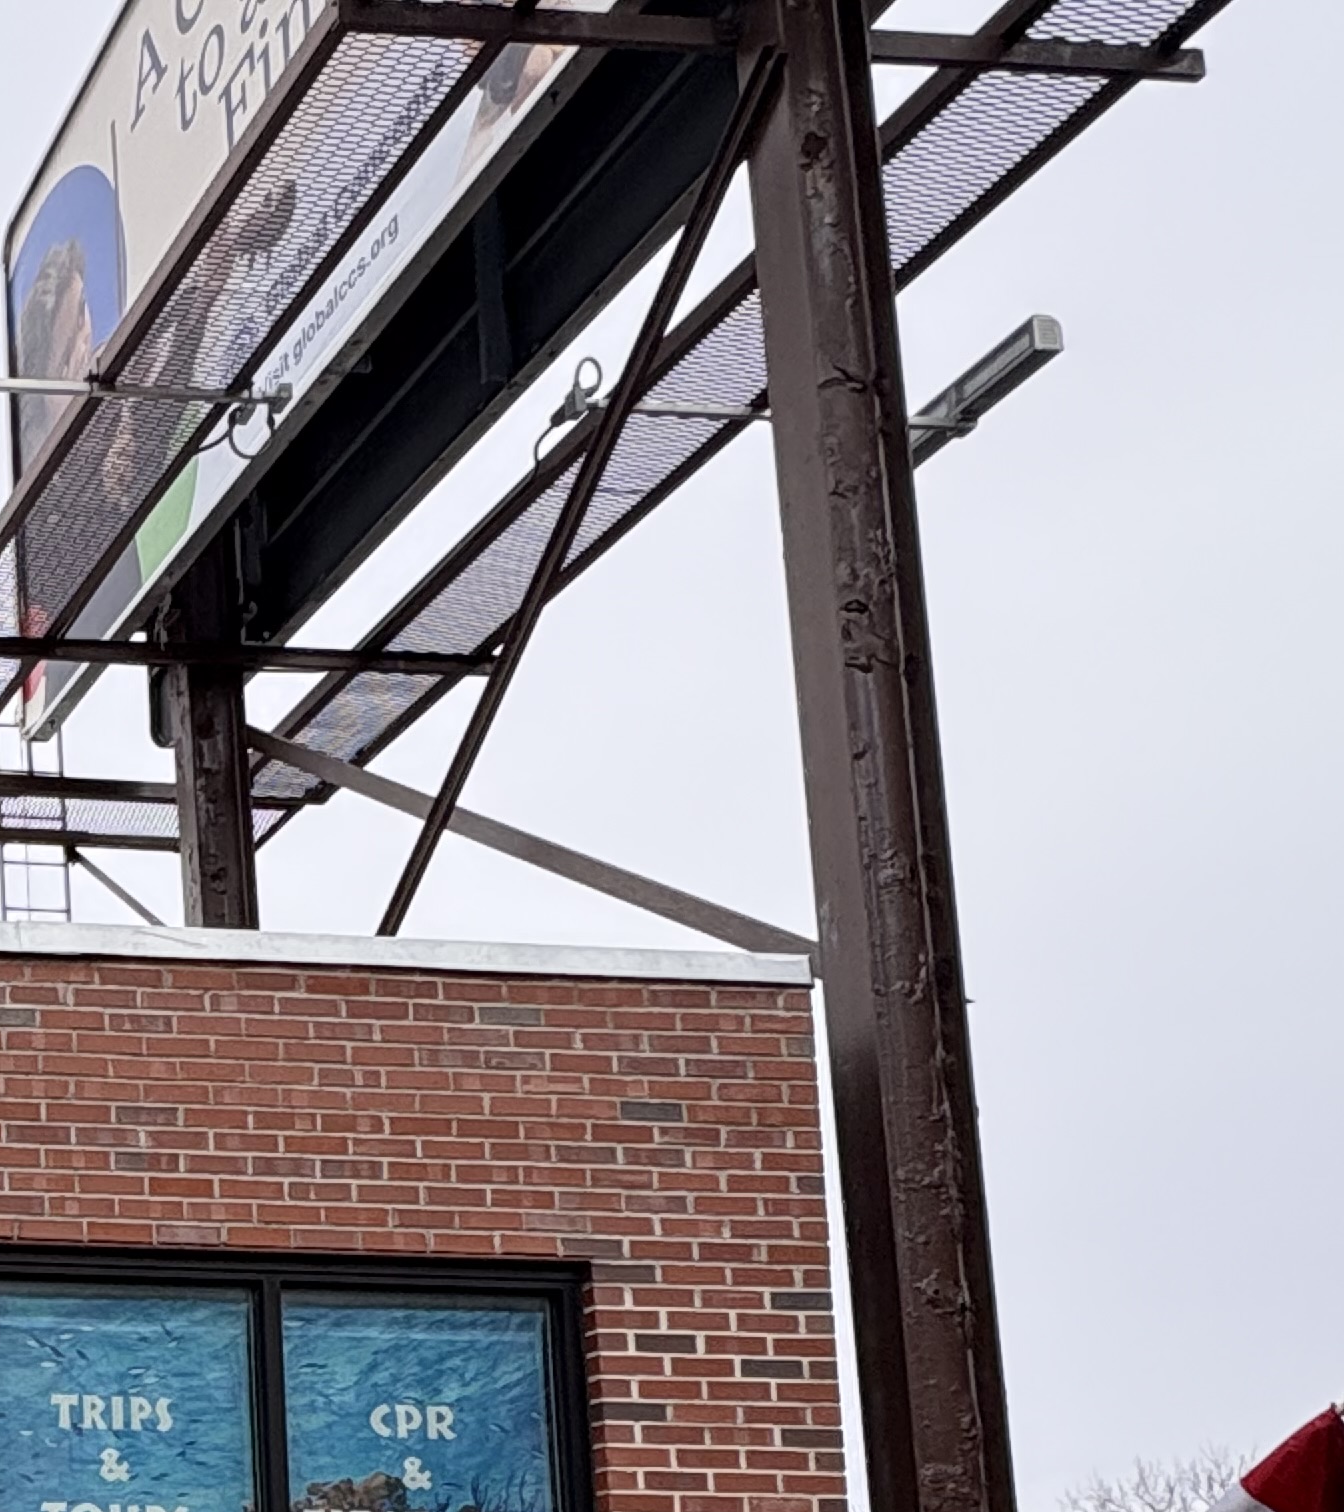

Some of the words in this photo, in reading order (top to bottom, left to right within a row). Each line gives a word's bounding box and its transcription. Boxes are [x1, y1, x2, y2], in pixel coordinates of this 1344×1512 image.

[130, 28, 168, 133] A
[175, 24, 225, 132] to
[218, 0, 311, 149] Fin
[292, 213, 399, 366] globalccs.org
[50, 1394, 174, 1432] TRIPS
[369, 1404, 457, 1441] CPR
[99, 1448, 131, 1482] &
[402, 1456, 432, 1491] &
